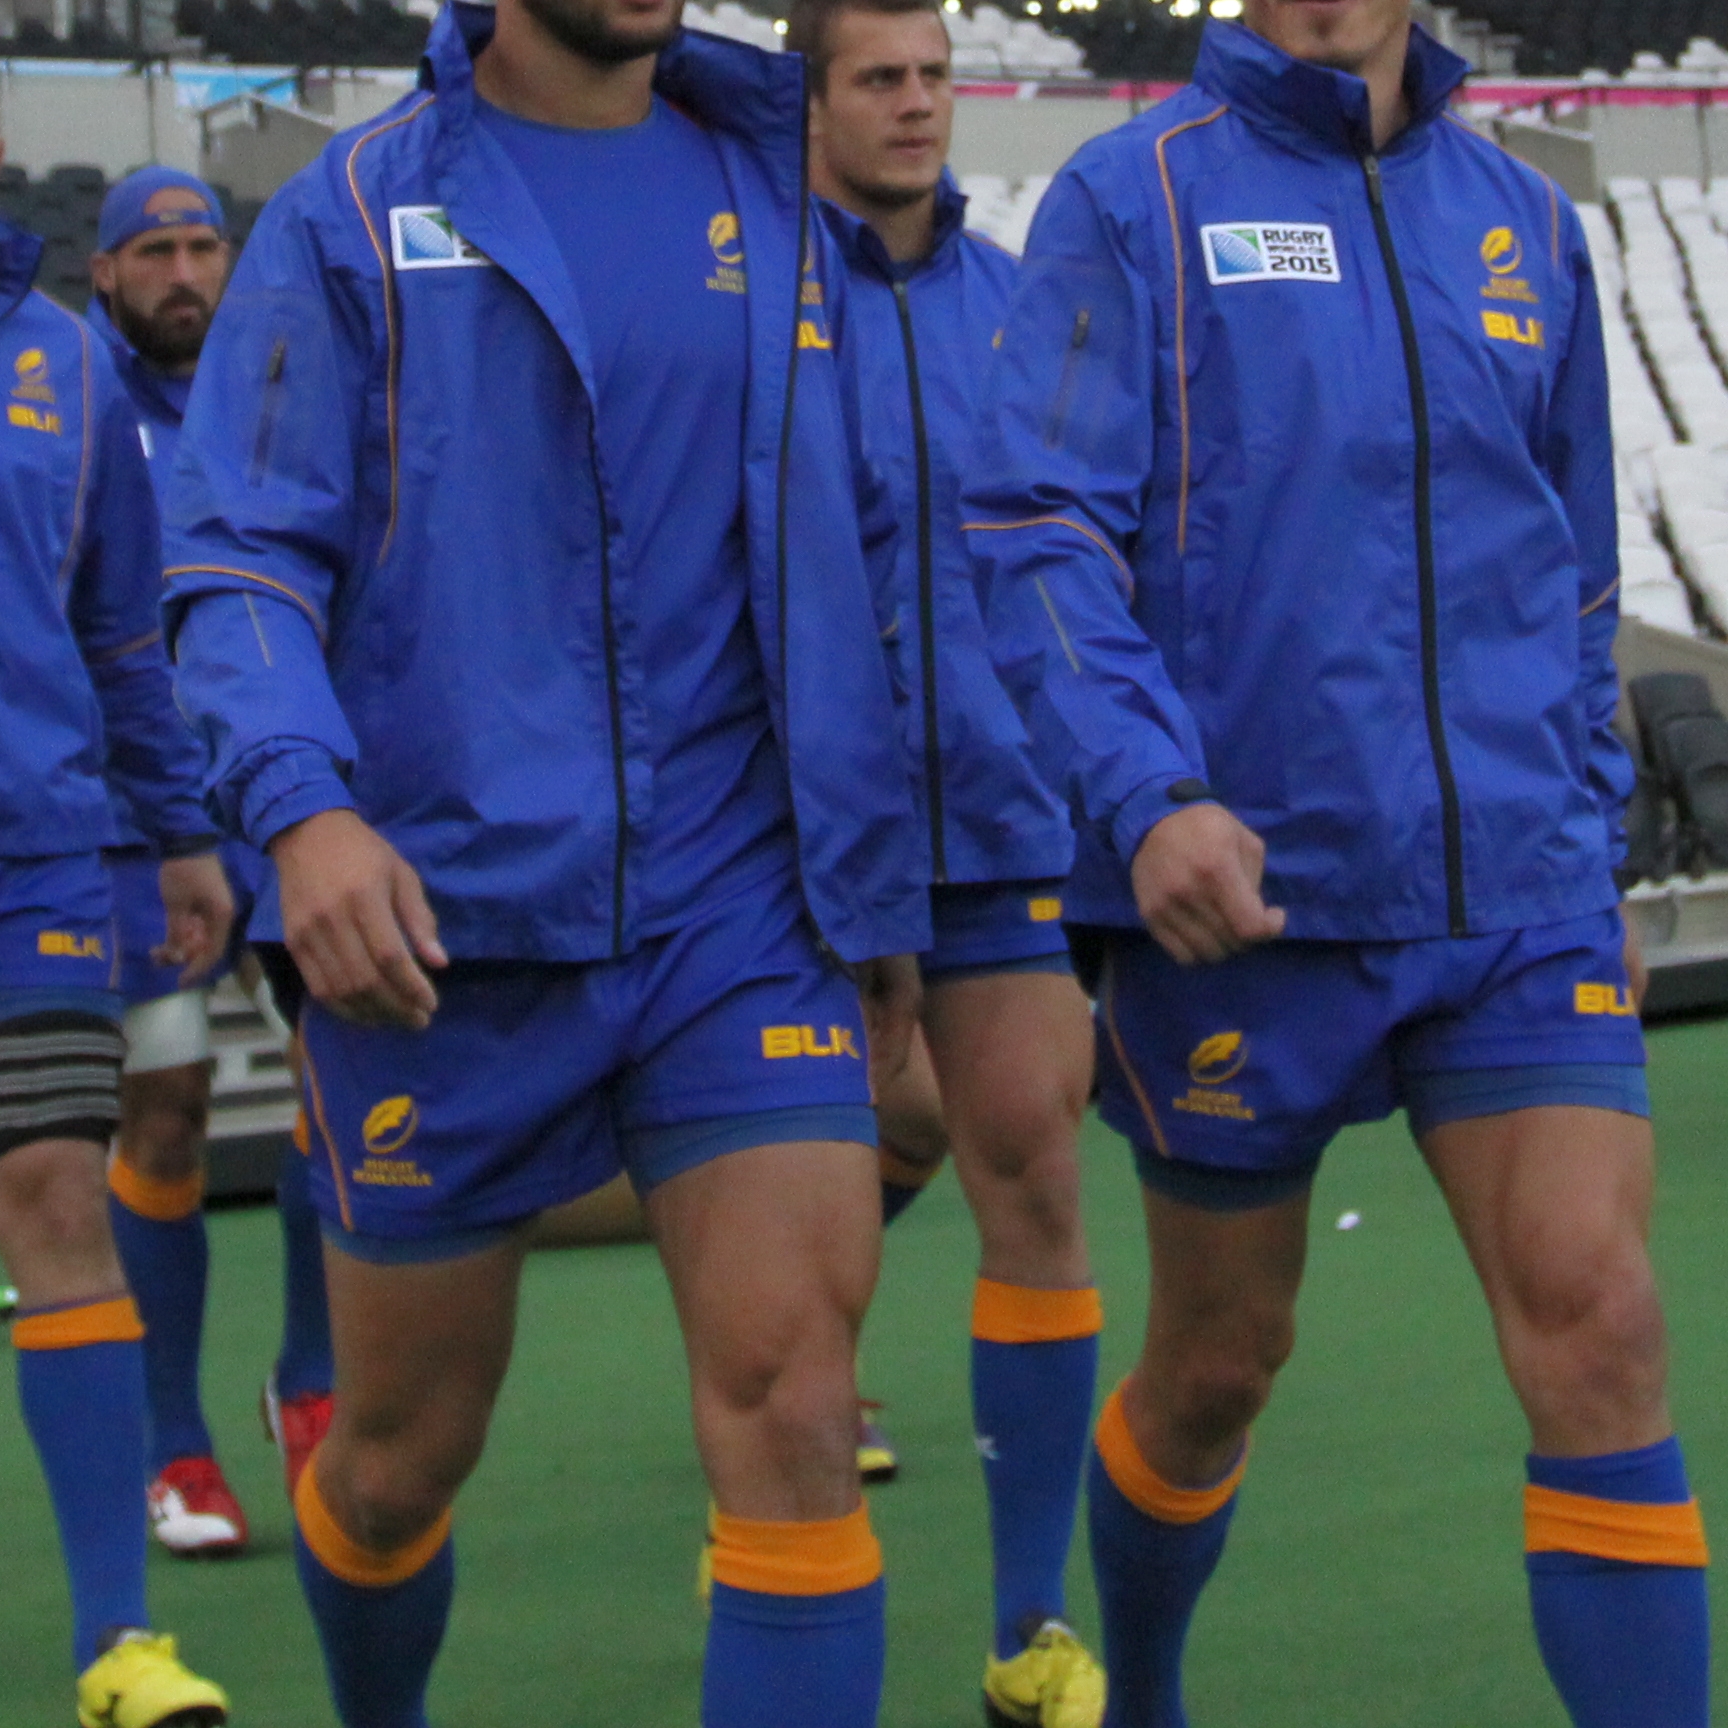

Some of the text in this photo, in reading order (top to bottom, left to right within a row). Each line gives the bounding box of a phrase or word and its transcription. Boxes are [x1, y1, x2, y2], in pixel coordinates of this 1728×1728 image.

[1262, 229, 1324, 245] RUGBY
[1268, 255, 1333, 274] 2015
[761, 1024, 861, 1060] BLK
